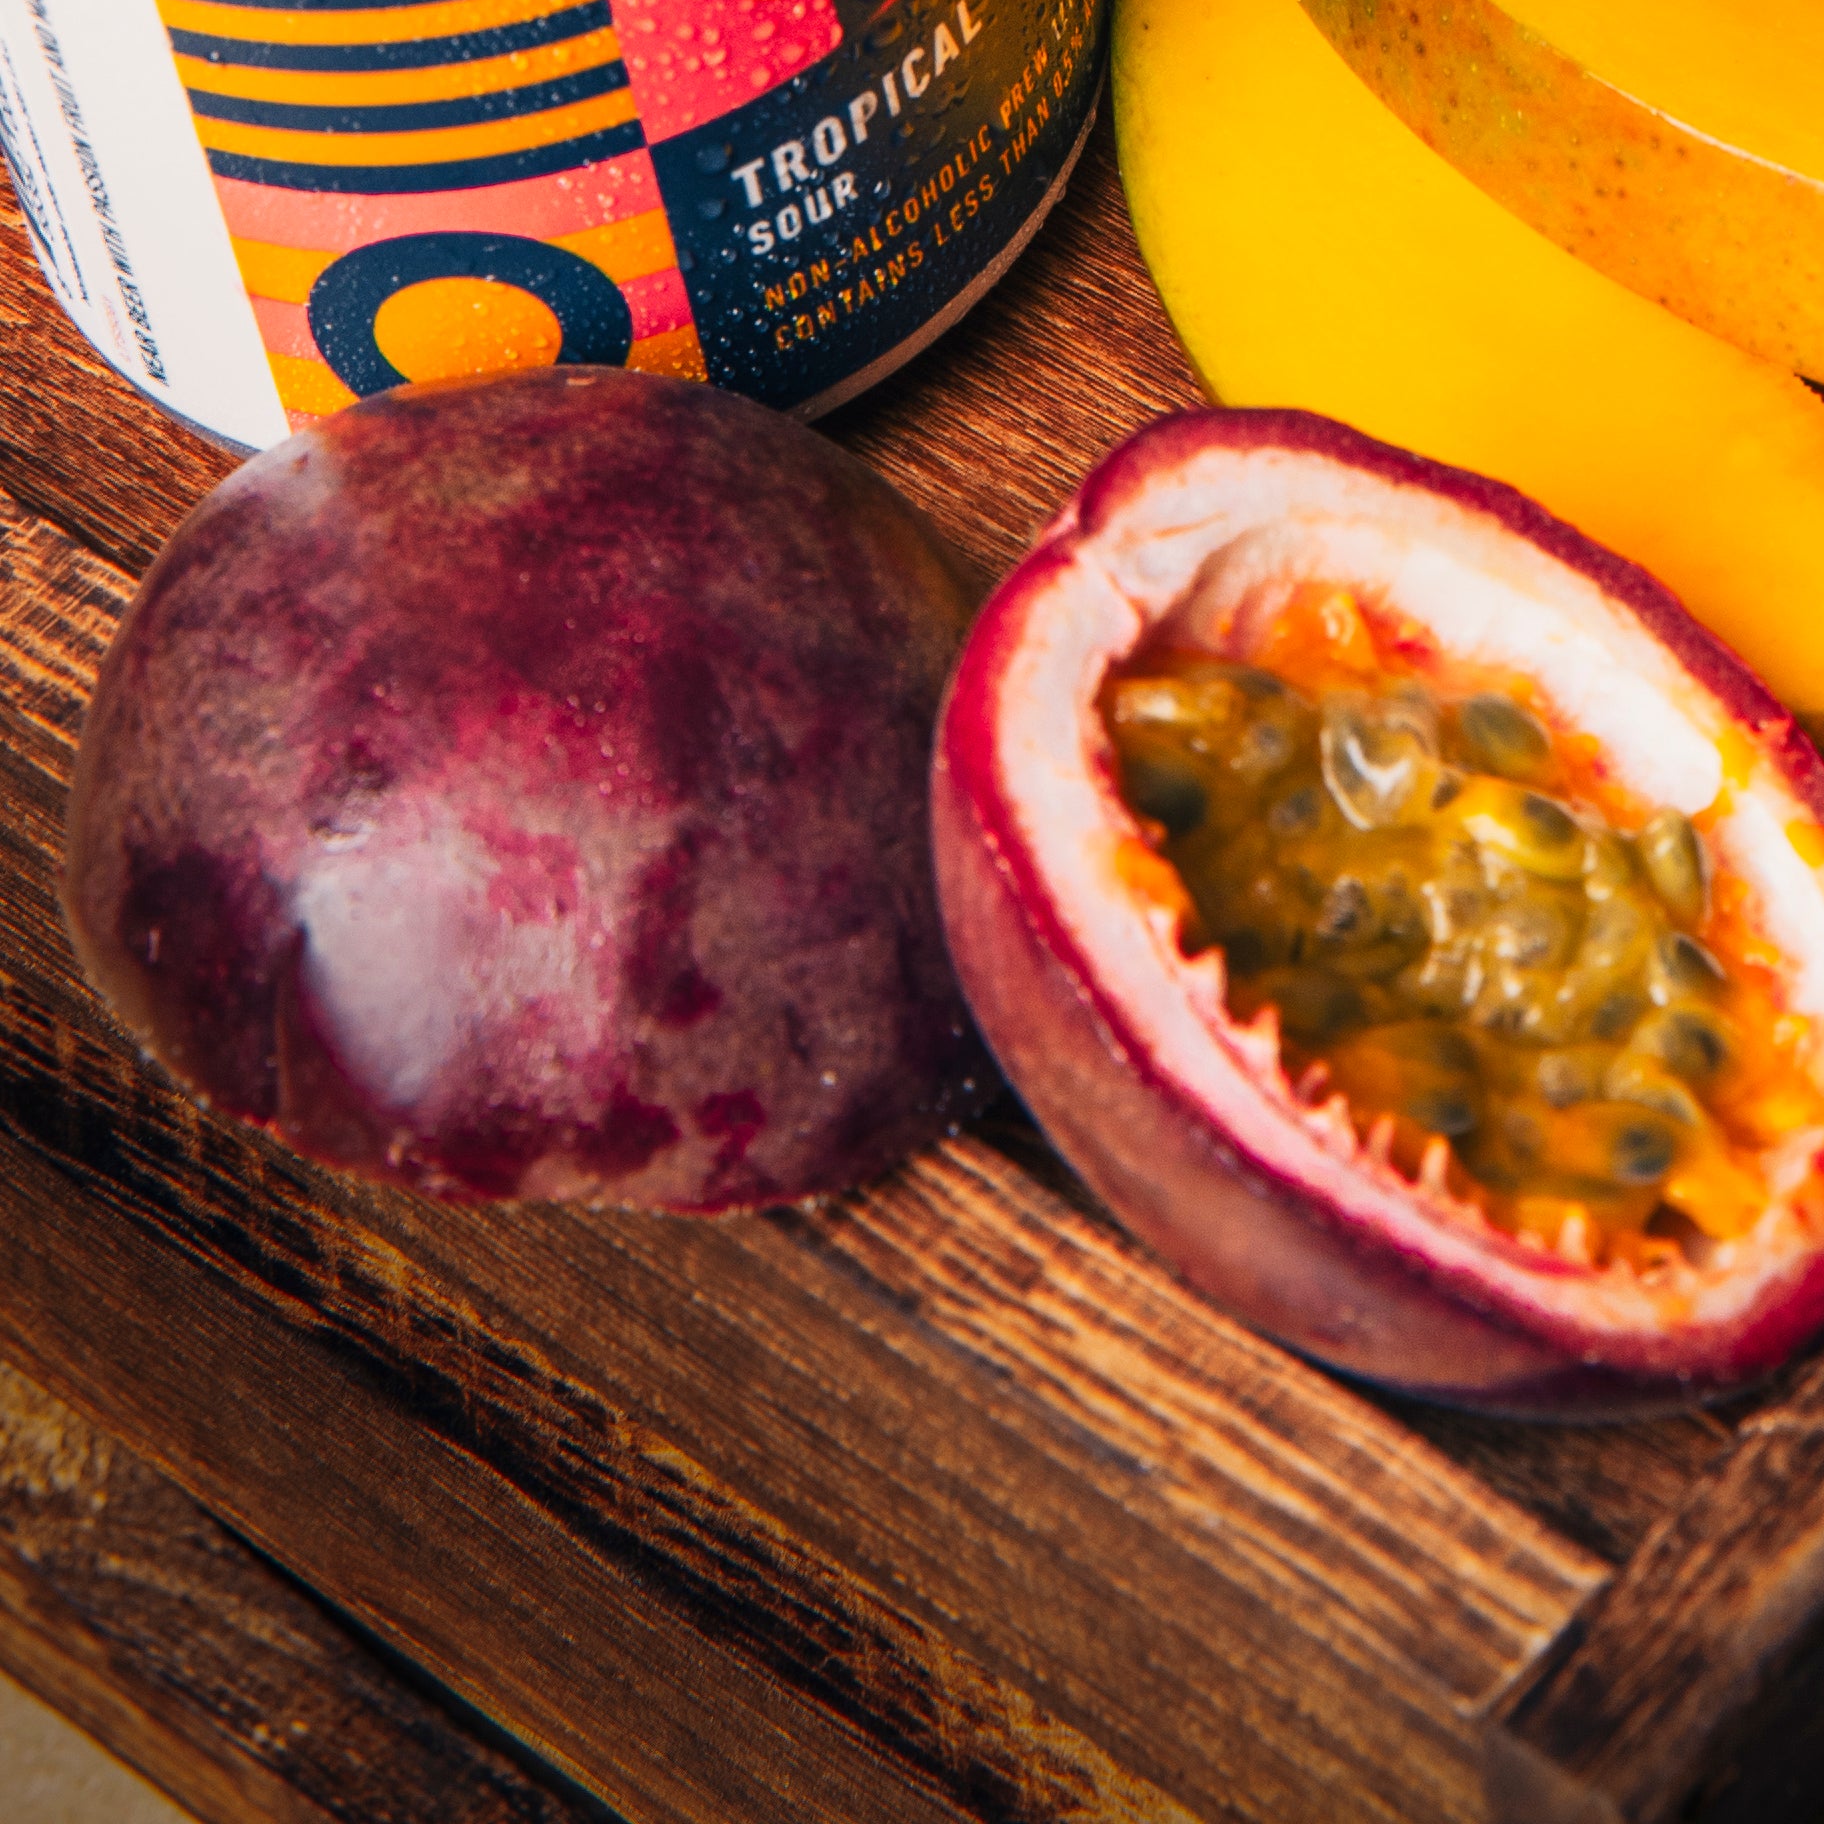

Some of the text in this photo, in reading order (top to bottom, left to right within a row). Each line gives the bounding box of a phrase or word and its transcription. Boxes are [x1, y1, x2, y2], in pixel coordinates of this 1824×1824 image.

[746, 169, 860, 257] SOUR
[762, 122, 994, 312] NON-ALCOHOLIC
[773, 240, 926, 354] CONTAINS
[932, 172, 996, 248] LESS
[998, 95, 1051, 177] THAN
